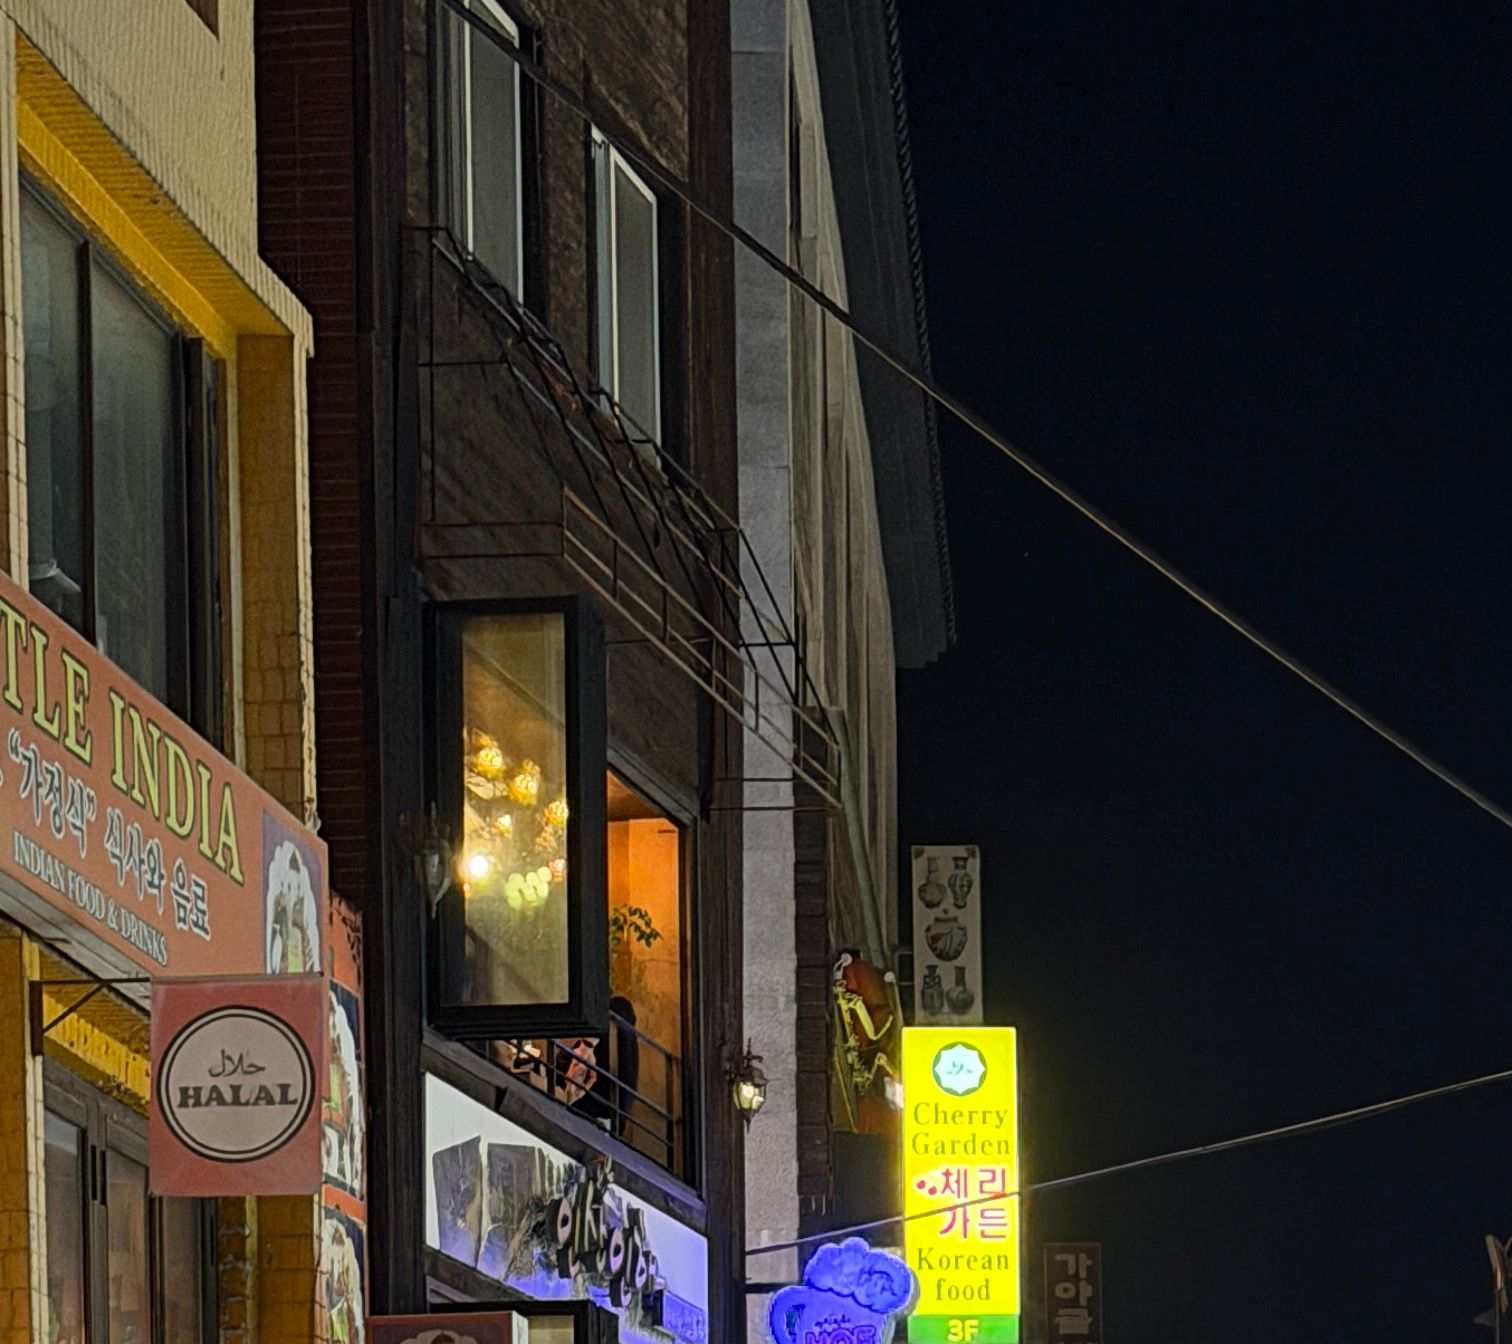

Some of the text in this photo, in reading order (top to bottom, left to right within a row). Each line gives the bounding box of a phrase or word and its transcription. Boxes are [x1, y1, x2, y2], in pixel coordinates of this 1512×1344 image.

[108, 686, 245, 887] INDIA
[104, 806, 166, 916] 식사와
[171, 857, 211, 942] 음료
[13, 831, 168, 967] INDIAN FOOD & DRINKS
[207, 1048, 266, 1078] حلال
[177, 1083, 299, 1110] HALAL
[913, 1101, 1008, 1129] Cherry
[912, 1132, 1011, 1158] Garden
[939, 1167, 1008, 1199] 체리
[938, 1208, 1009, 1241] 가든
[916, 1247, 1010, 1272] Korean
[935, 1276, 992, 1302] food
[947, 1318, 980, 1342] 3F
